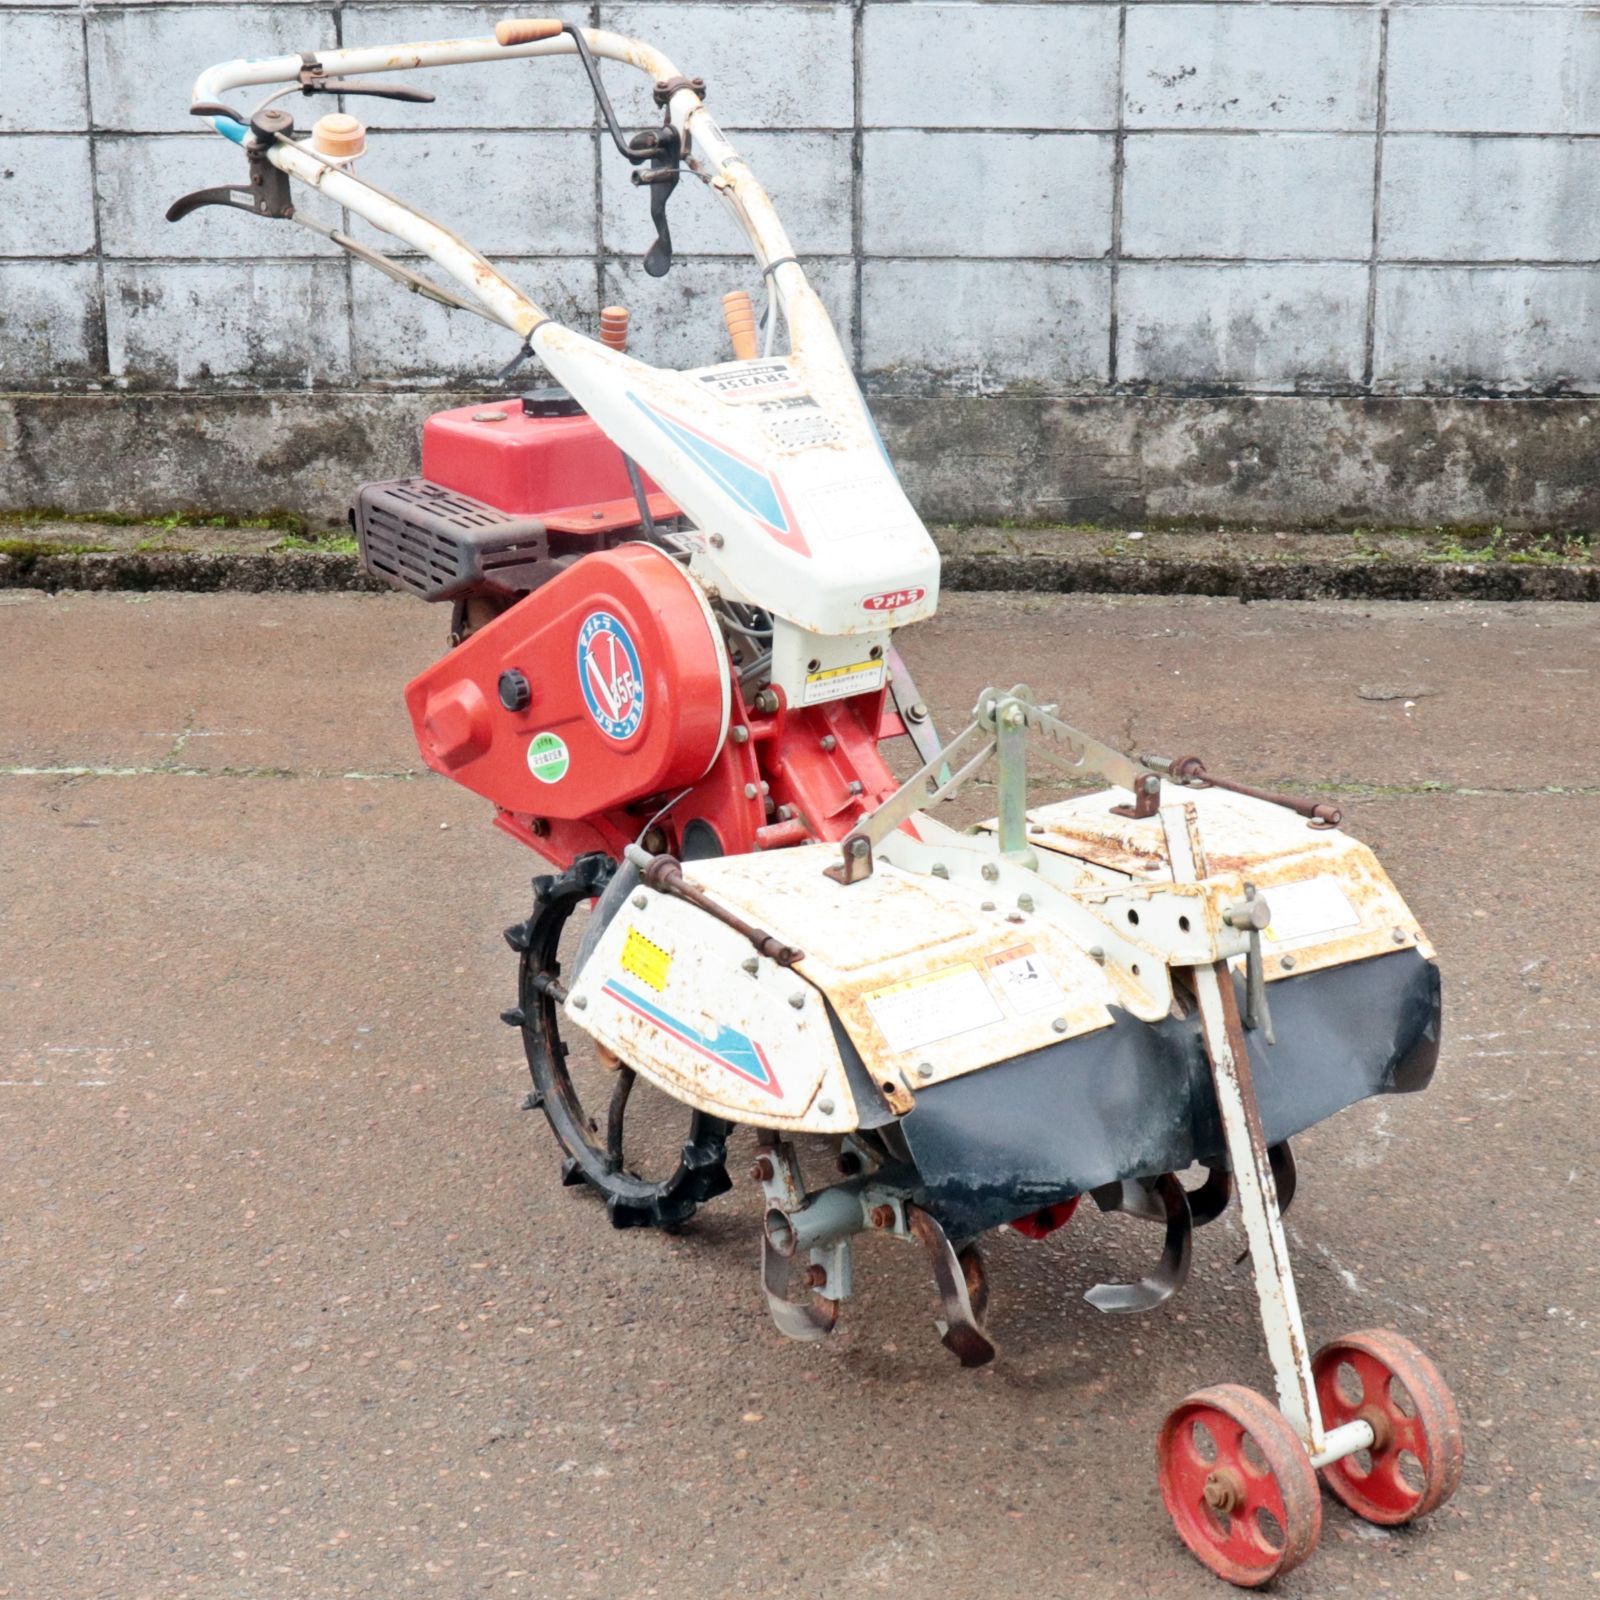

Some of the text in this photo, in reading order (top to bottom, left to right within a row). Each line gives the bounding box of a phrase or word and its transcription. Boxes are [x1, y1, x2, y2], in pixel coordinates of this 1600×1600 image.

[718, 372, 790, 391] SRV35F
[872, 590, 918, 608] マメトラ
[579, 615, 613, 647] マメトラ
